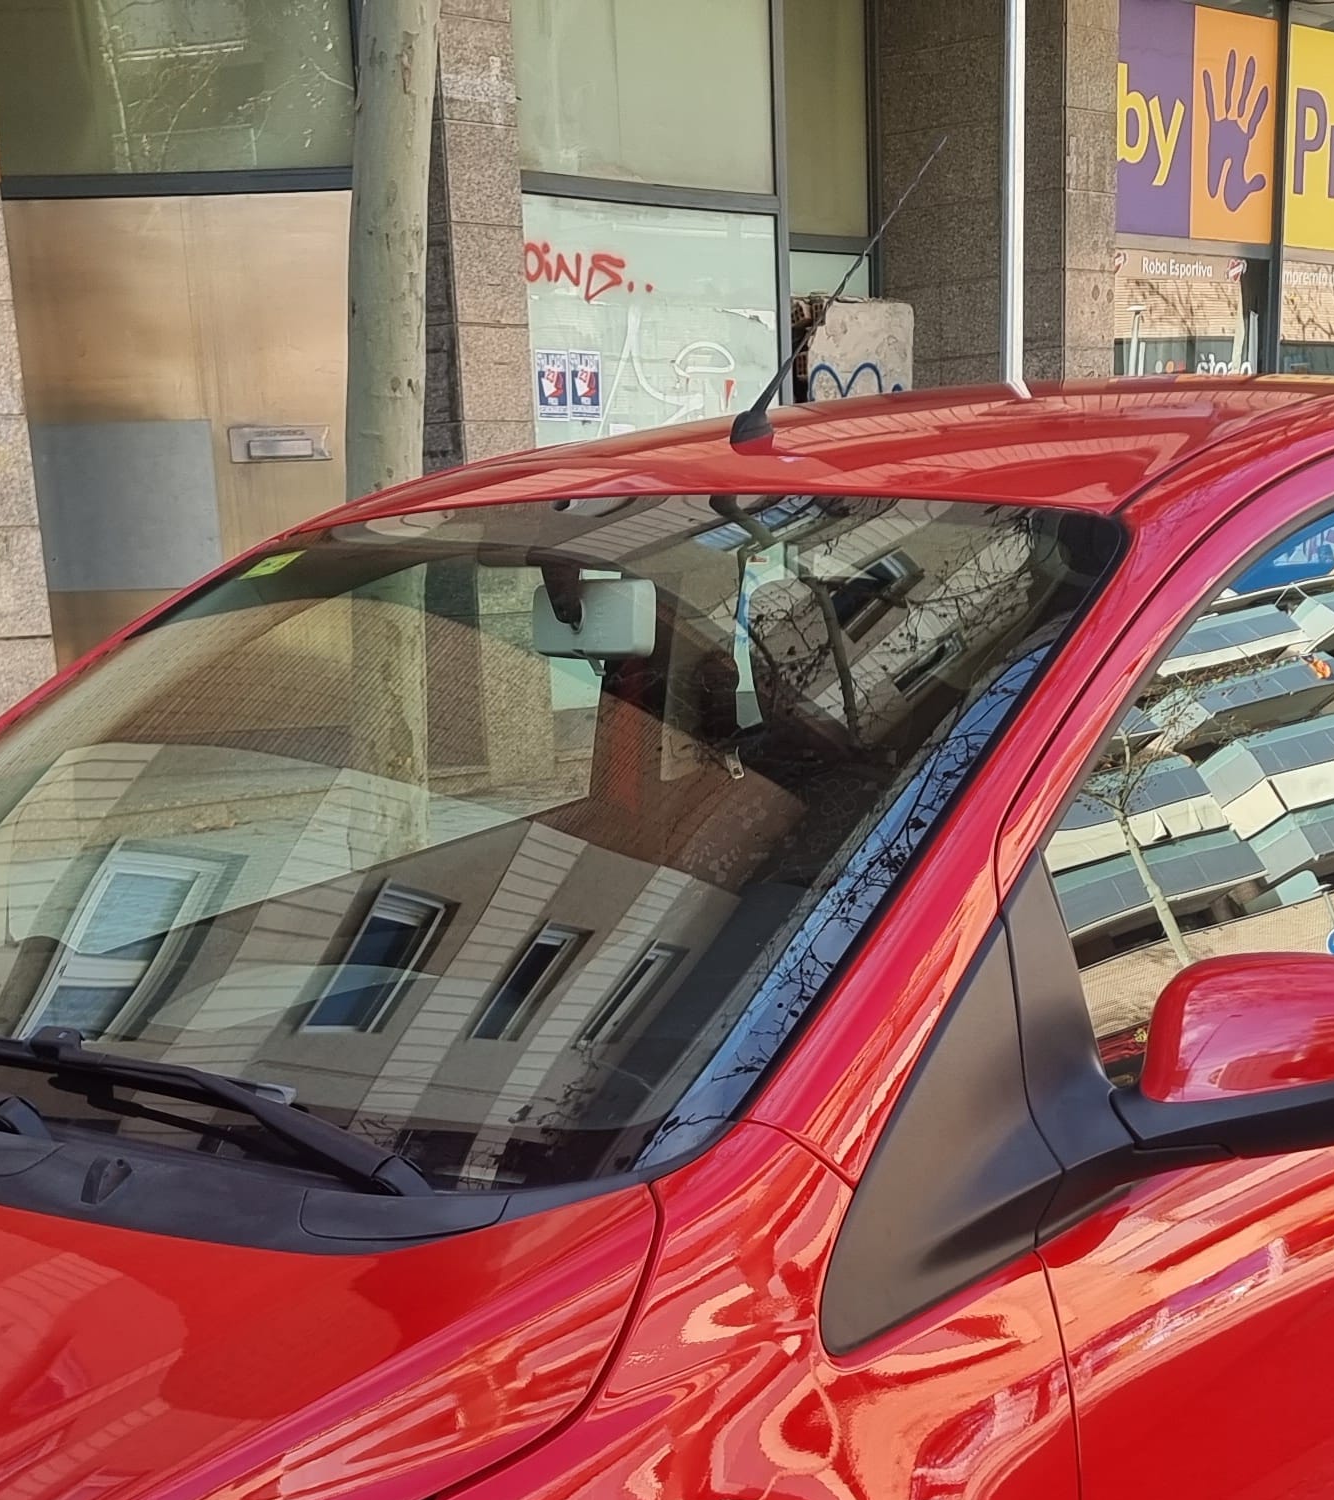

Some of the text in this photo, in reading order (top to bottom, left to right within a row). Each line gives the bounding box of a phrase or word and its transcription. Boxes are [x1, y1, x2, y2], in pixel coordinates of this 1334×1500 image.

[1117, 62, 1185, 187] by
[1142, 256, 1213, 279] Roba Esportiva
